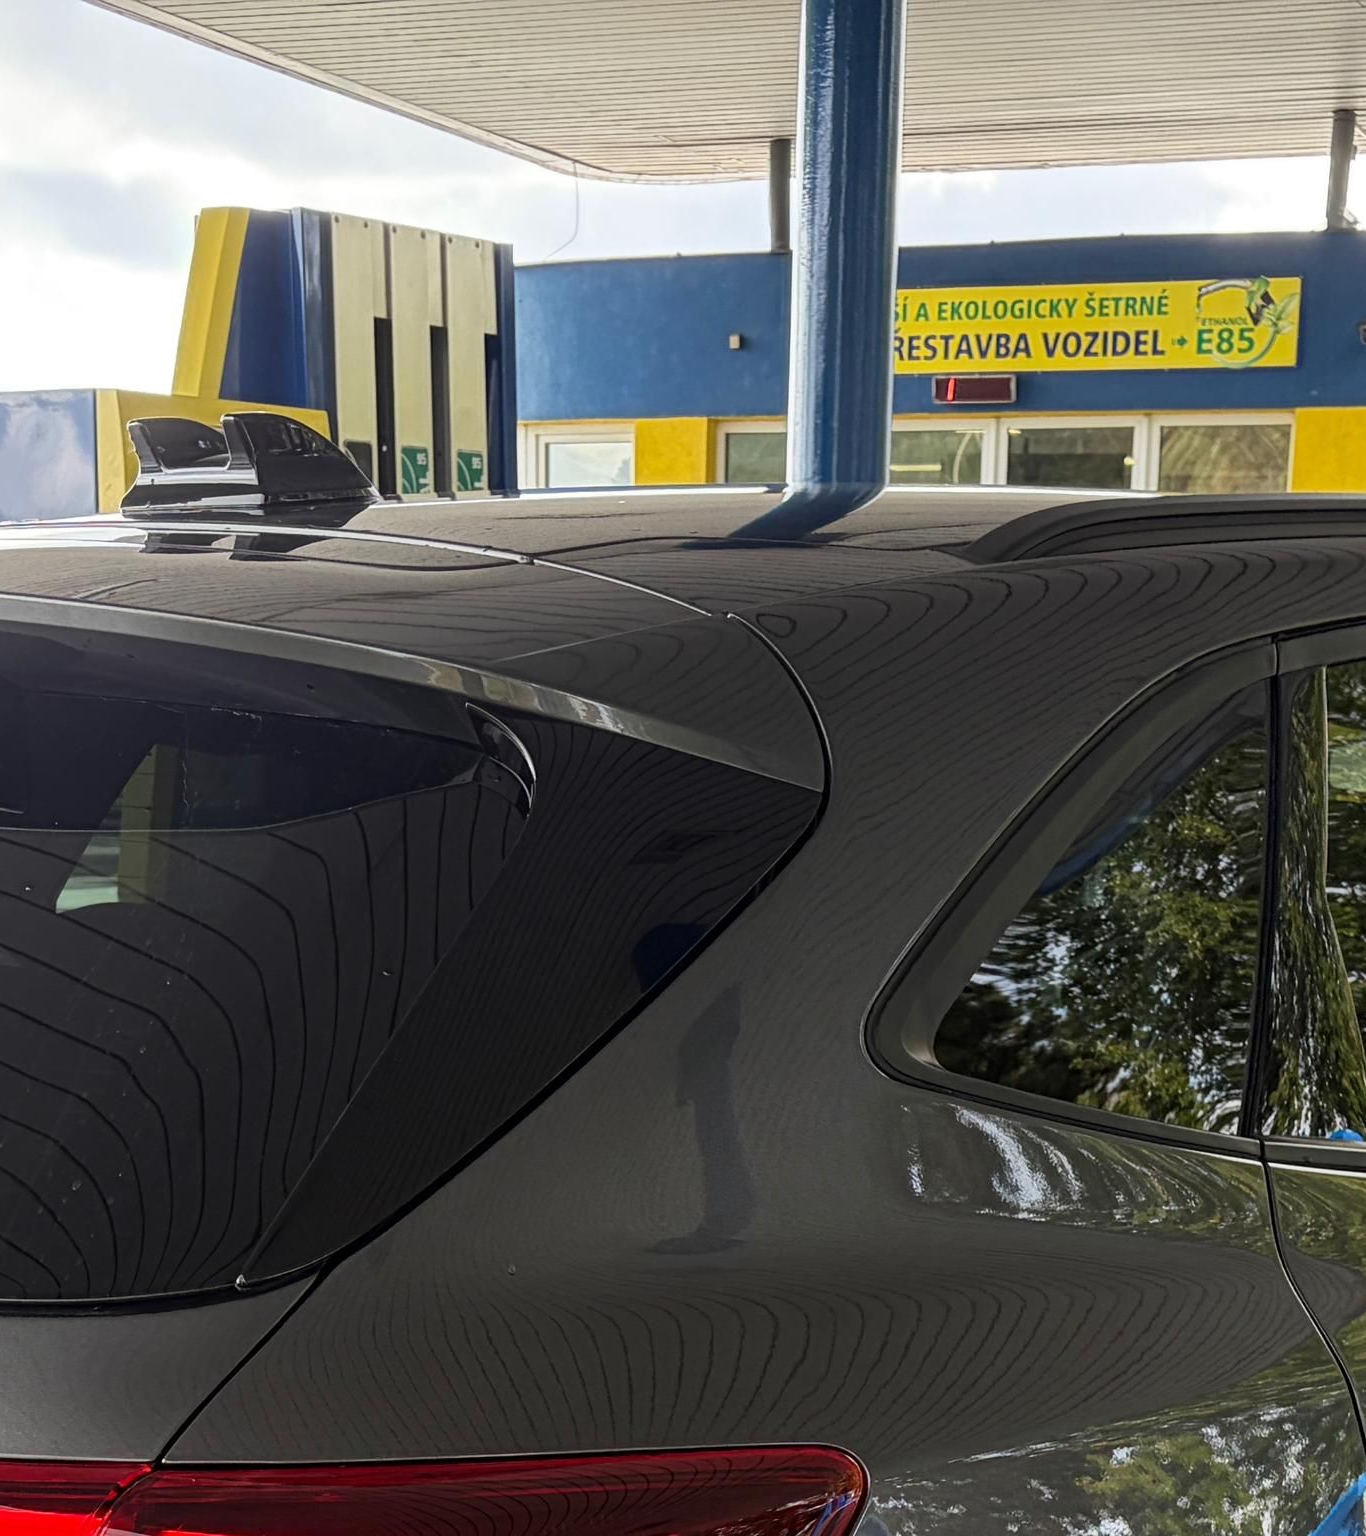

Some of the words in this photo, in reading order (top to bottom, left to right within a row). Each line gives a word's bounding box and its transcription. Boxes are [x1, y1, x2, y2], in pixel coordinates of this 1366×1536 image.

[915, 302, 930, 322] A
[937, 298, 1078, 321] EKOLOGICKY
[1084, 289, 1170, 318] ŠETRNÉ
[1041, 330, 1166, 359] VOZIDEL
[1196, 327, 1256, 355] E85
